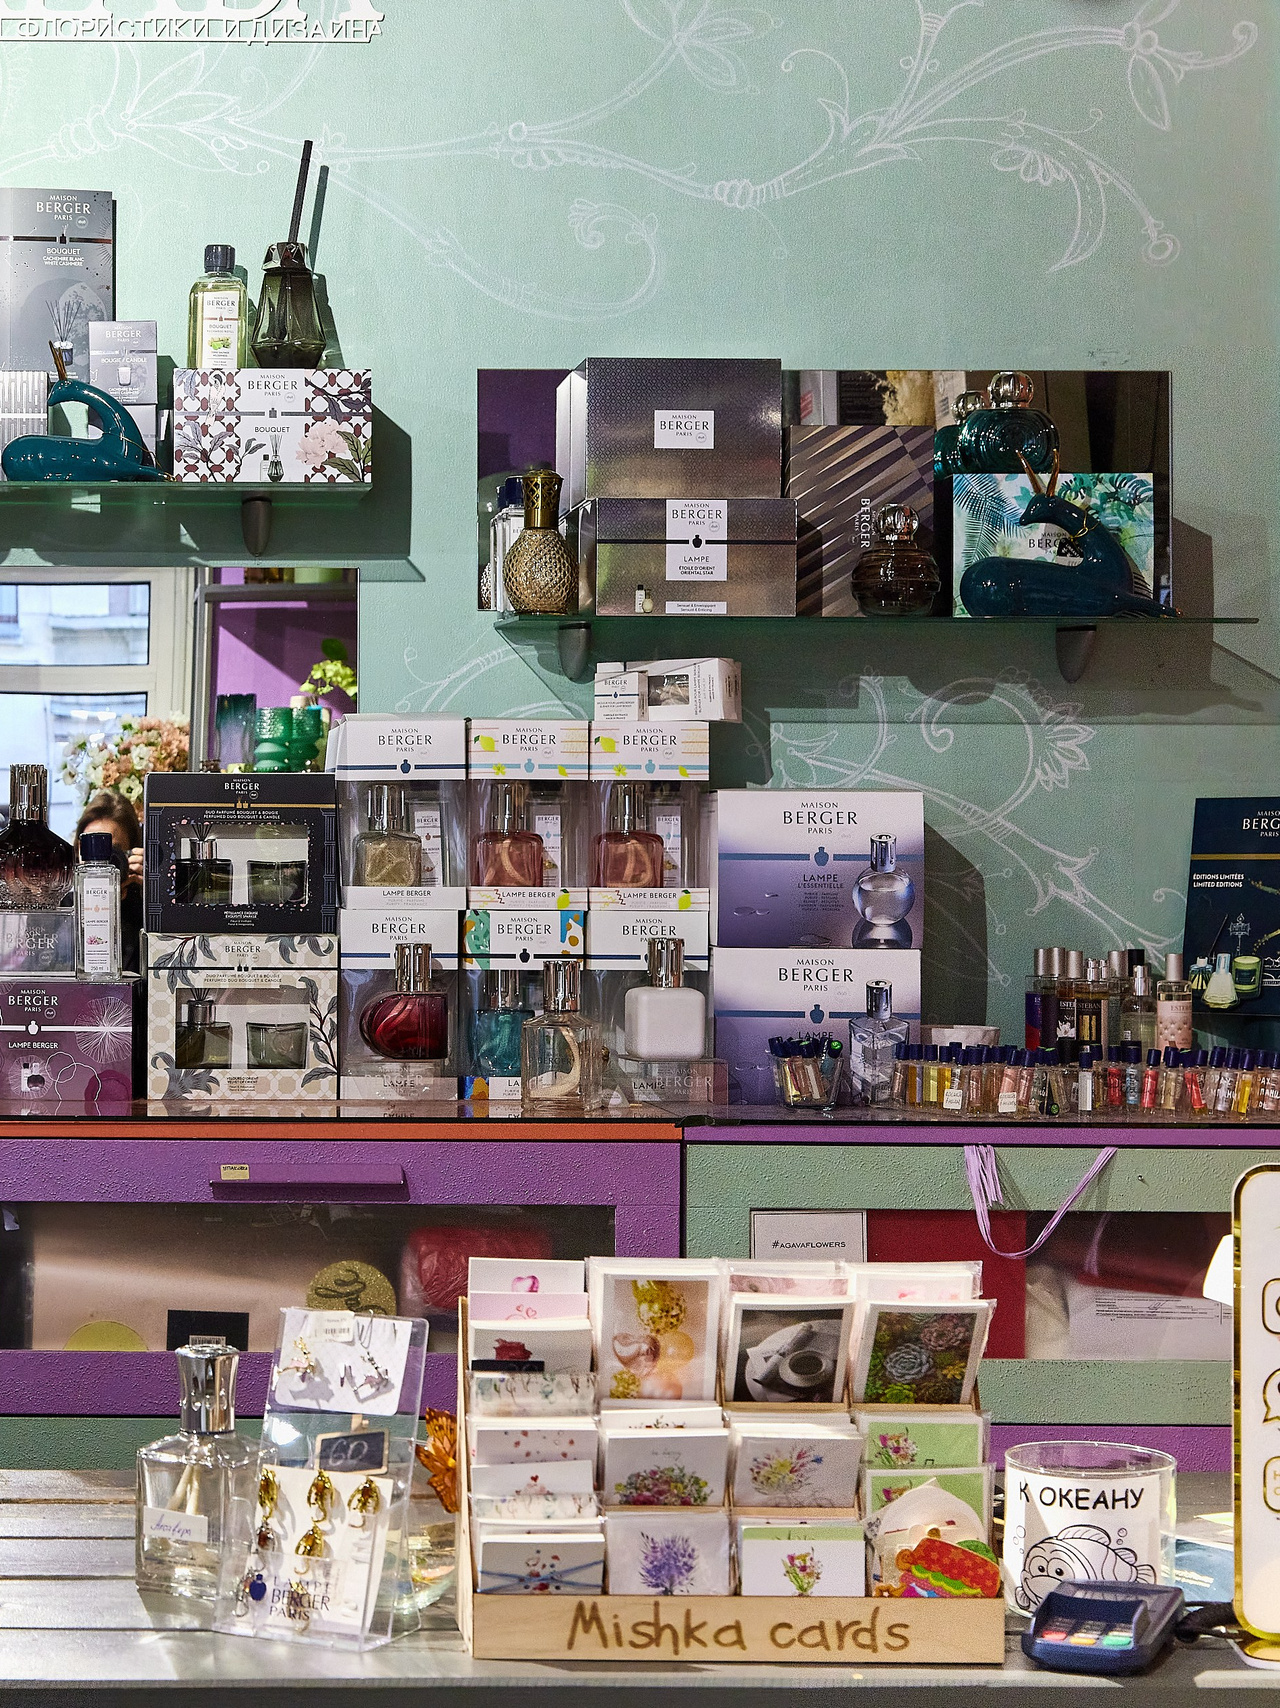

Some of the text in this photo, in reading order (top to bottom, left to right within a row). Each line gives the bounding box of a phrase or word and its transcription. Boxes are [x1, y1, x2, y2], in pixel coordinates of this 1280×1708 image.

[18, 17, 210, 38] ФЛОРИСТИКИ
[226, 19, 242, 38] И
[248, 19, 382, 46] ДИЗАЙНА
[36, 202, 91, 214] BERGER
[206, 299, 236, 307] BERGER
[105, 330, 142, 339] BERGER
[248, 380, 298, 391] BERGER
[254, 425, 291, 434] BOUQUET
[659, 420, 710, 431] BERGER
[671, 509, 723, 520] BERGER
[859, 498, 870, 549] BERGER
[378, 735, 433, 746] BERGER
[502, 734, 557, 745] BERGER
[623, 735, 678, 746] BERGER
[224, 782, 260, 791] BERGER
[783, 811, 858, 825] BERGER
[1242, 818, 1280, 830] BERG
[807, 827, 833, 835] PARIS
[803, 874, 838, 882] LAMPE
[1193, 872, 1245, 880] ÉDITIONS LIMITÉES
[371, 923, 426, 934] BERGER
[497, 924, 552, 935] BERGER
[622, 925, 677, 936] BERGER
[224, 945, 261, 953] BERGER
[778, 967, 854, 982] BERGER
[8, 995, 59, 1006] BERGER
[798, 1031, 834, 1039] LAMPE
[32, 1041, 59, 1049] BERGER
[771, 1240, 846, 1250] #AGAVAFLOWERS
[1019, 1482, 1145, 1511] К ОКЕАНУ
[566, 1600, 911, 1656] Mishka cards
